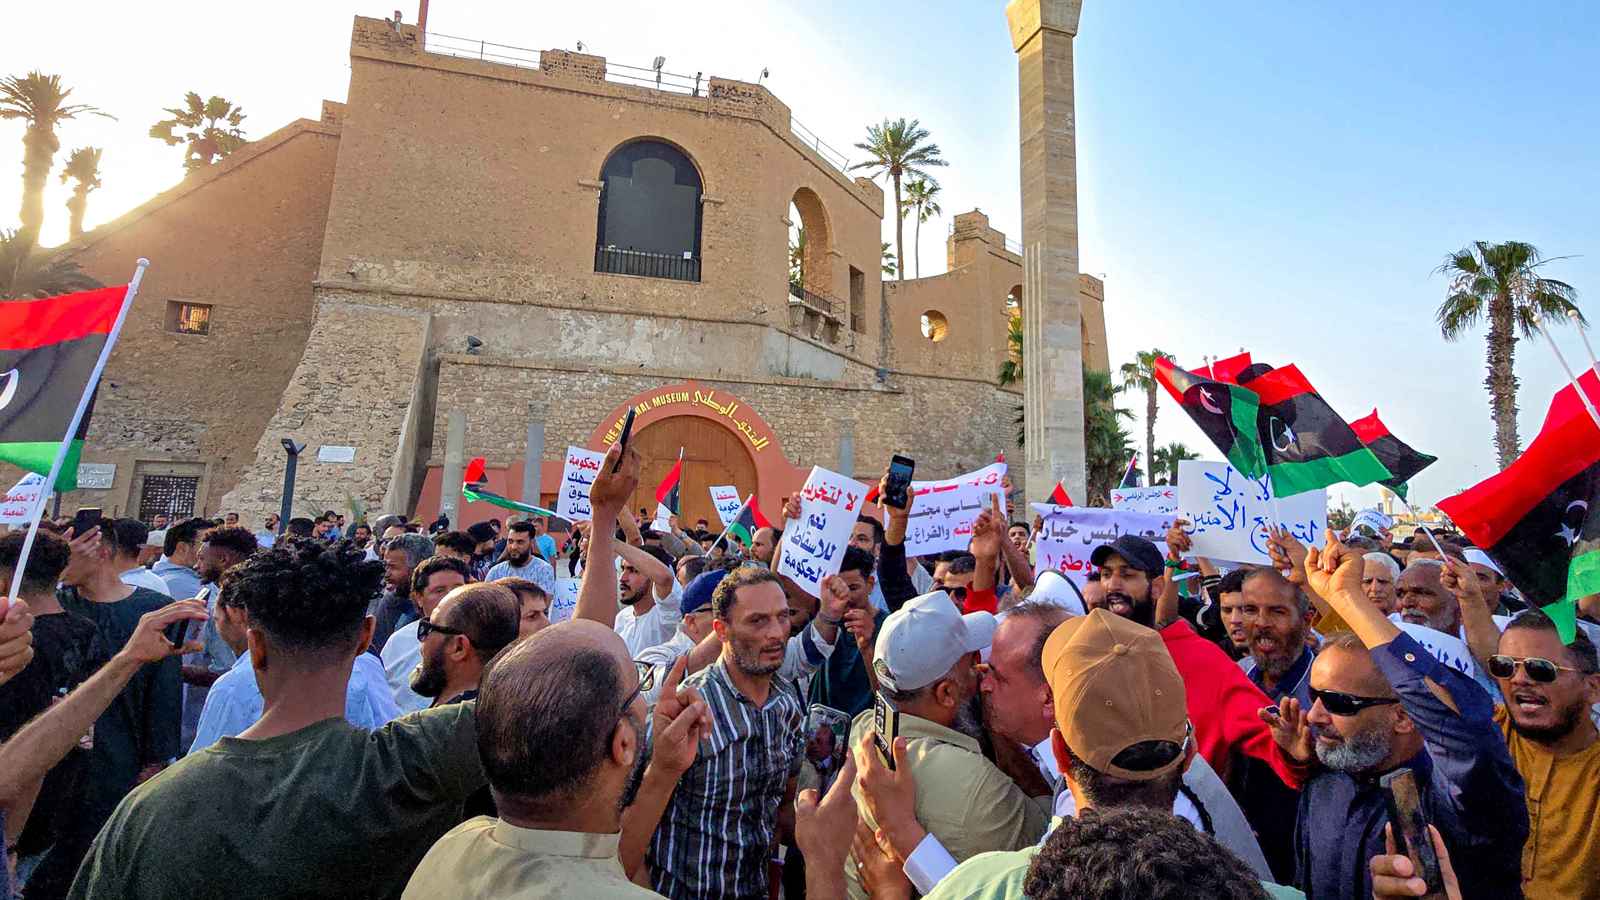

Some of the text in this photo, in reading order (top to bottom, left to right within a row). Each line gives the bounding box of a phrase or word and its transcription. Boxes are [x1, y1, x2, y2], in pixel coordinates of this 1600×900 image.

[692, 390, 739, 418] الوطني
[603, 392, 690, 446] THE NANAL MUSEUM
[569, 454, 601, 471] لحكومة
[845, 492, 859, 512] لا
[807, 512, 827, 532] نعم
